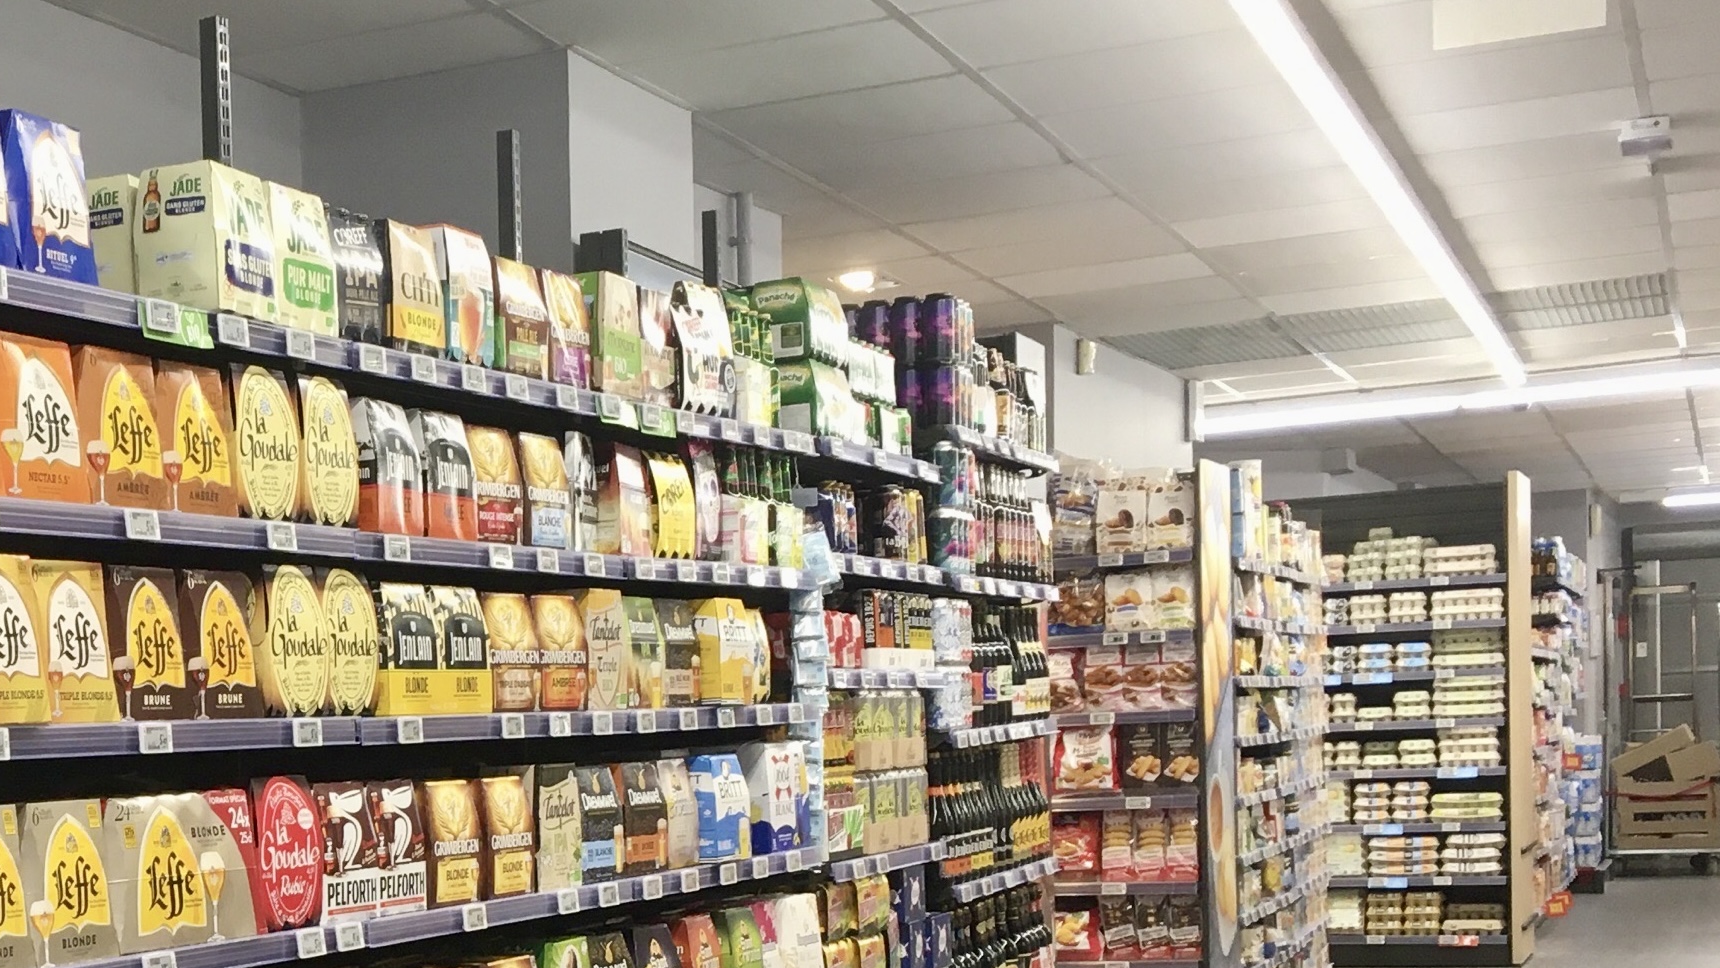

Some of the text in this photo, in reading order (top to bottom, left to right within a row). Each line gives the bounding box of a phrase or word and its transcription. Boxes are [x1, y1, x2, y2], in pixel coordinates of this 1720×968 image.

[22, 393, 71, 454] Leffe
[108, 405, 154, 465] Leffe
[54, 608, 101, 671] Leffe
[134, 618, 176, 679] Leffe
[209, 617, 248, 678] Leffe
[145, 693, 173, 708] BRUNE
[219, 692, 245, 707] BRUNE
[114, 803, 132, 822] 24
[190, 823, 227, 838] BLONDE
[261, 831, 322, 874] Goudale
[51, 855, 100, 919] Leffe
[146, 850, 196, 920] Leffe
[328, 876, 378, 908] PELFORTH
[447, 869, 470, 882] BLONDE
[61, 933, 97, 950] BLONDE
